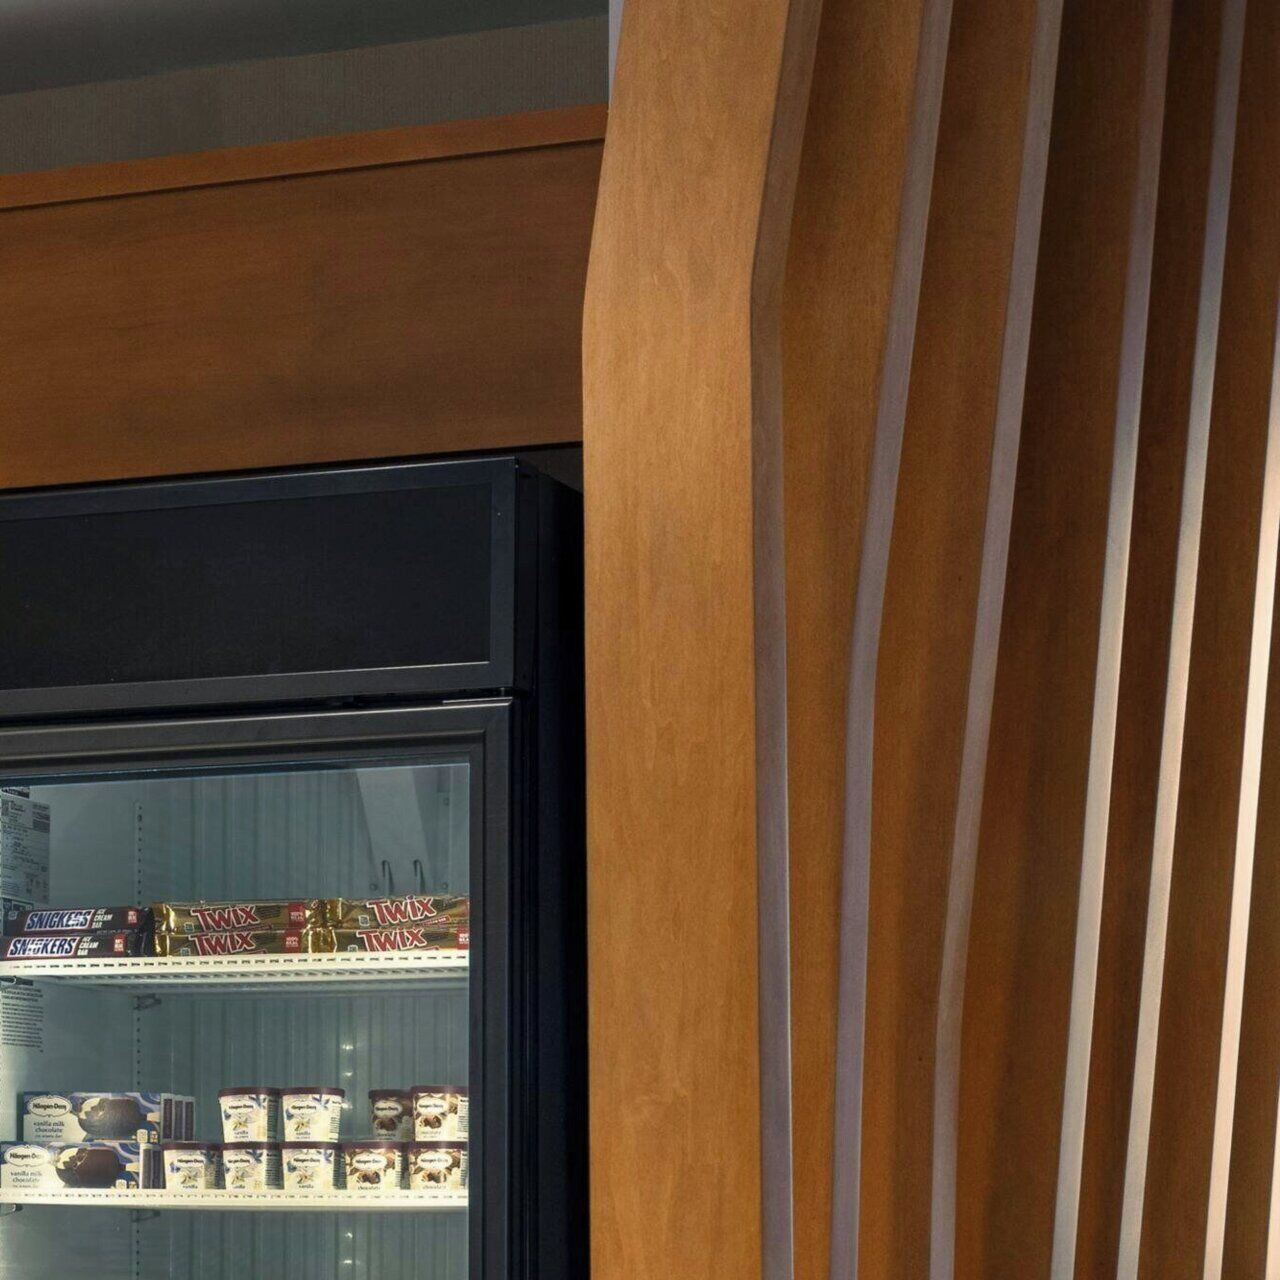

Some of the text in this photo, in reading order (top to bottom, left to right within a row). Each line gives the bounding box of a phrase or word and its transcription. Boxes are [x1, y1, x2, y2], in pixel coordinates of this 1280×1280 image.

[27, 911, 93, 929] SNICKERS
[190, 904, 260, 931] TWIX
[366, 895, 437, 926] TWIX
[188, 931, 256, 955] TWIX
[356, 928, 427, 951] TWIX
